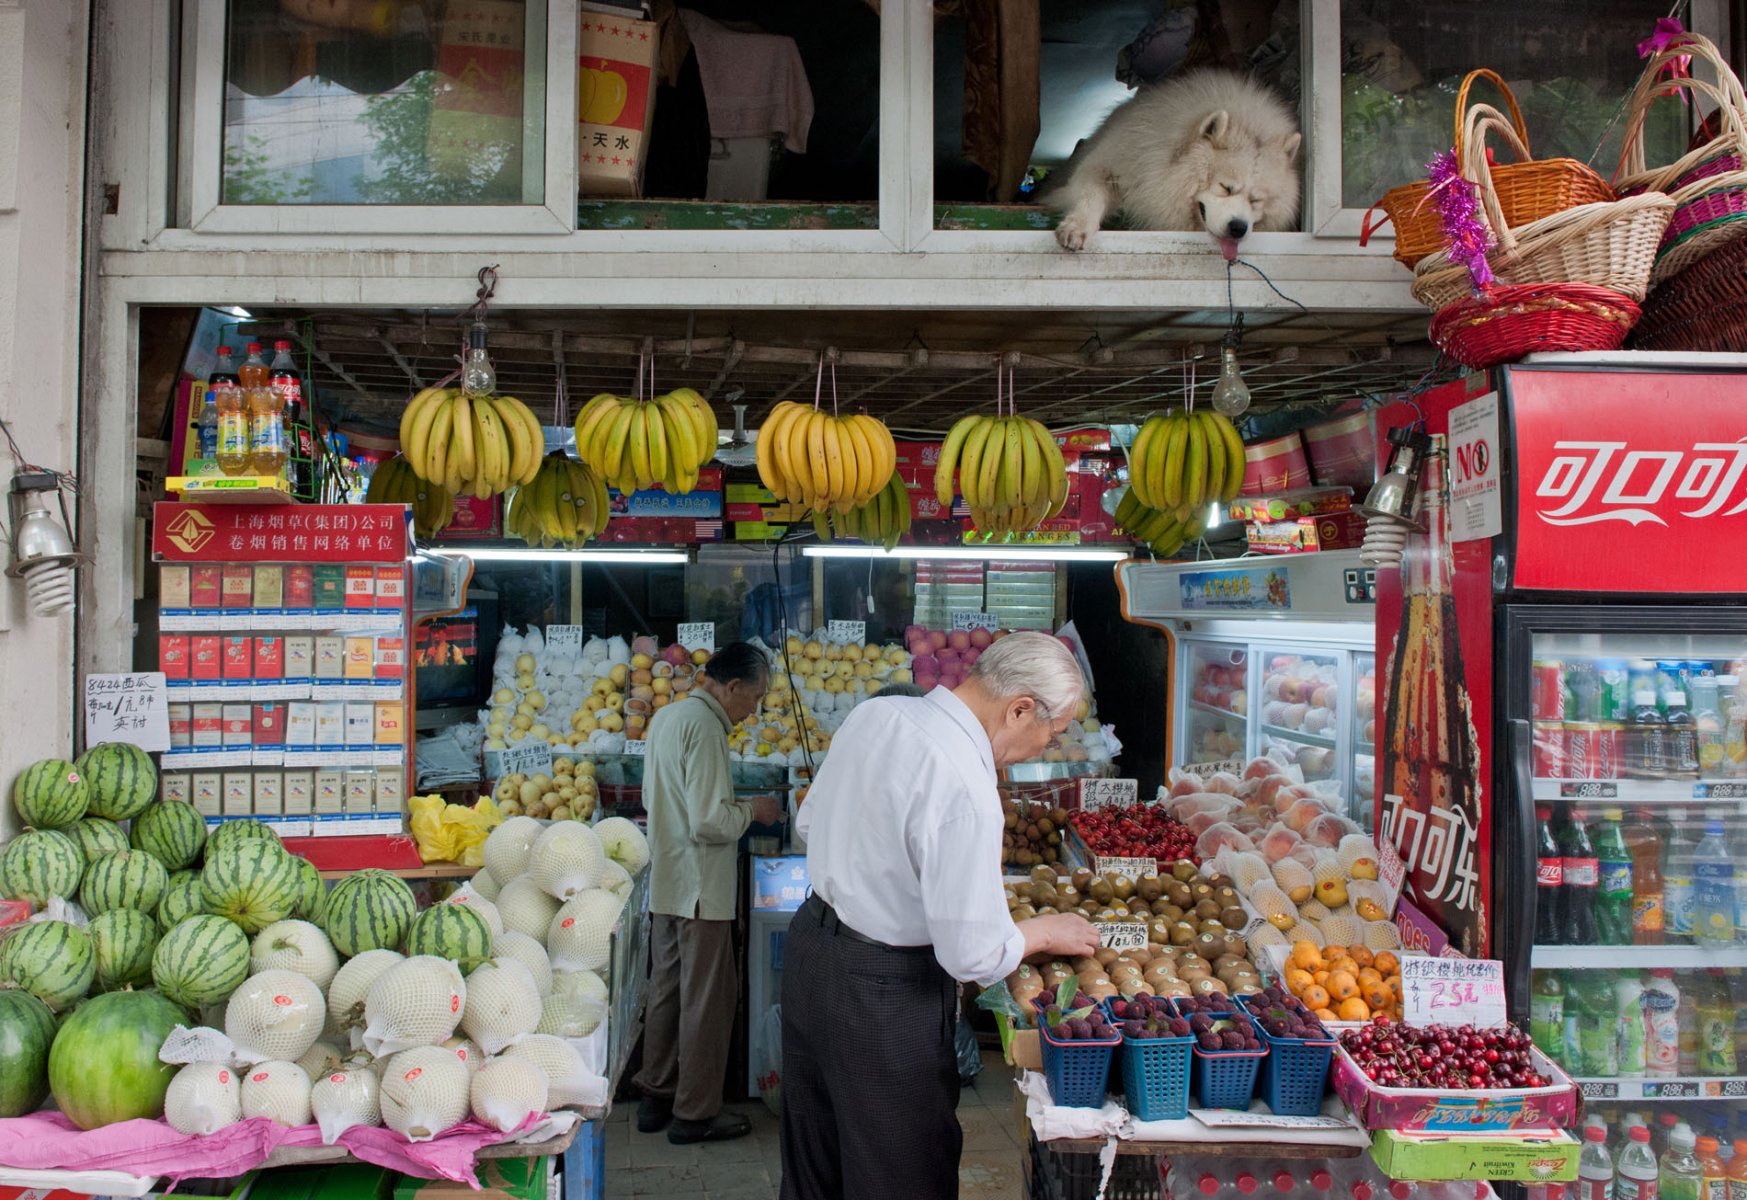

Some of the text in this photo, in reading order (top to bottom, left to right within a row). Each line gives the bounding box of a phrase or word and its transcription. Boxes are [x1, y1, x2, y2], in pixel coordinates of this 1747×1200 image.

[231, 514, 394, 531] 上海烟草(集团)公司
[229, 534, 393, 551] 卷烟销售网络单位
